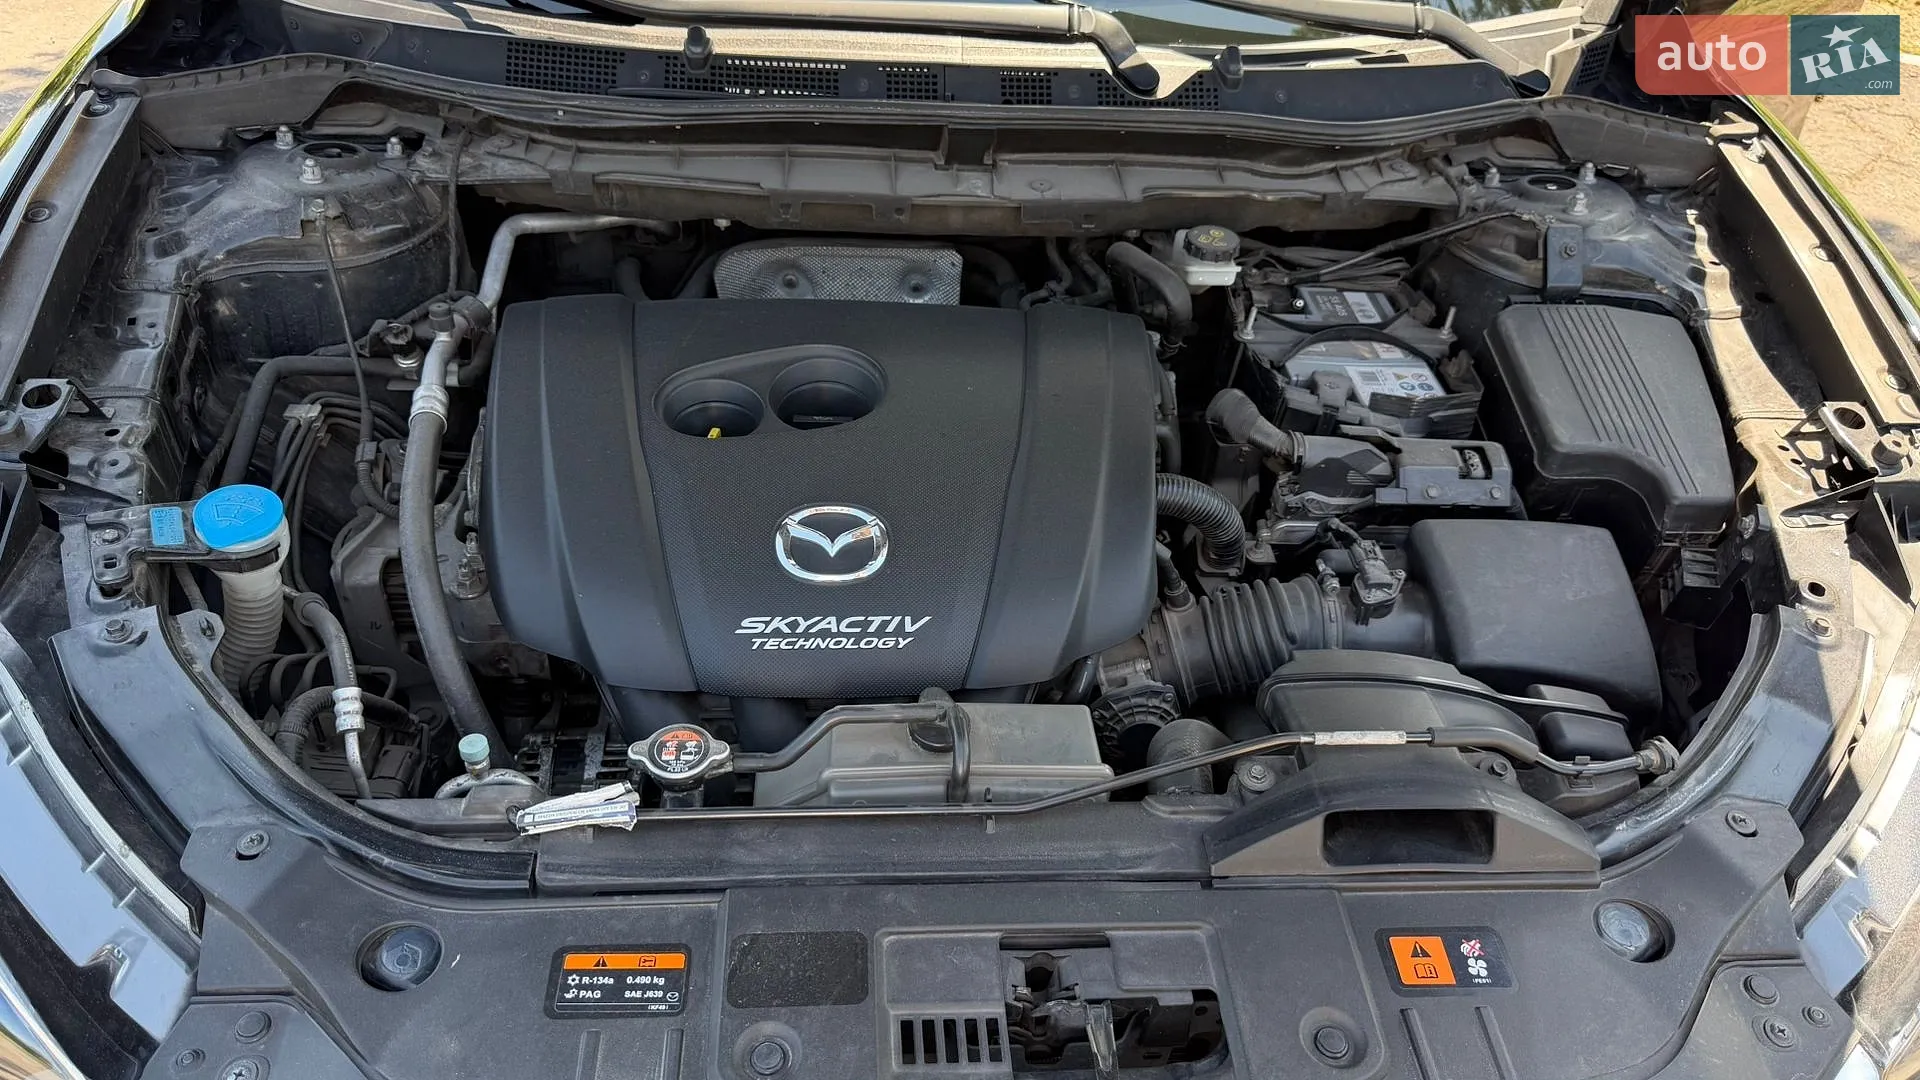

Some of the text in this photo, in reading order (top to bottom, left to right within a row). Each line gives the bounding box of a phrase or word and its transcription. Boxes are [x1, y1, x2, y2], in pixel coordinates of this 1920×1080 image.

[734, 615, 933, 634] SKYACTIV
[751, 637, 914, 650] TECHNOLOGY
[581, 976, 665, 985] R-134a 0.490 kg
[579, 990, 664, 999] PAG SAE J639
